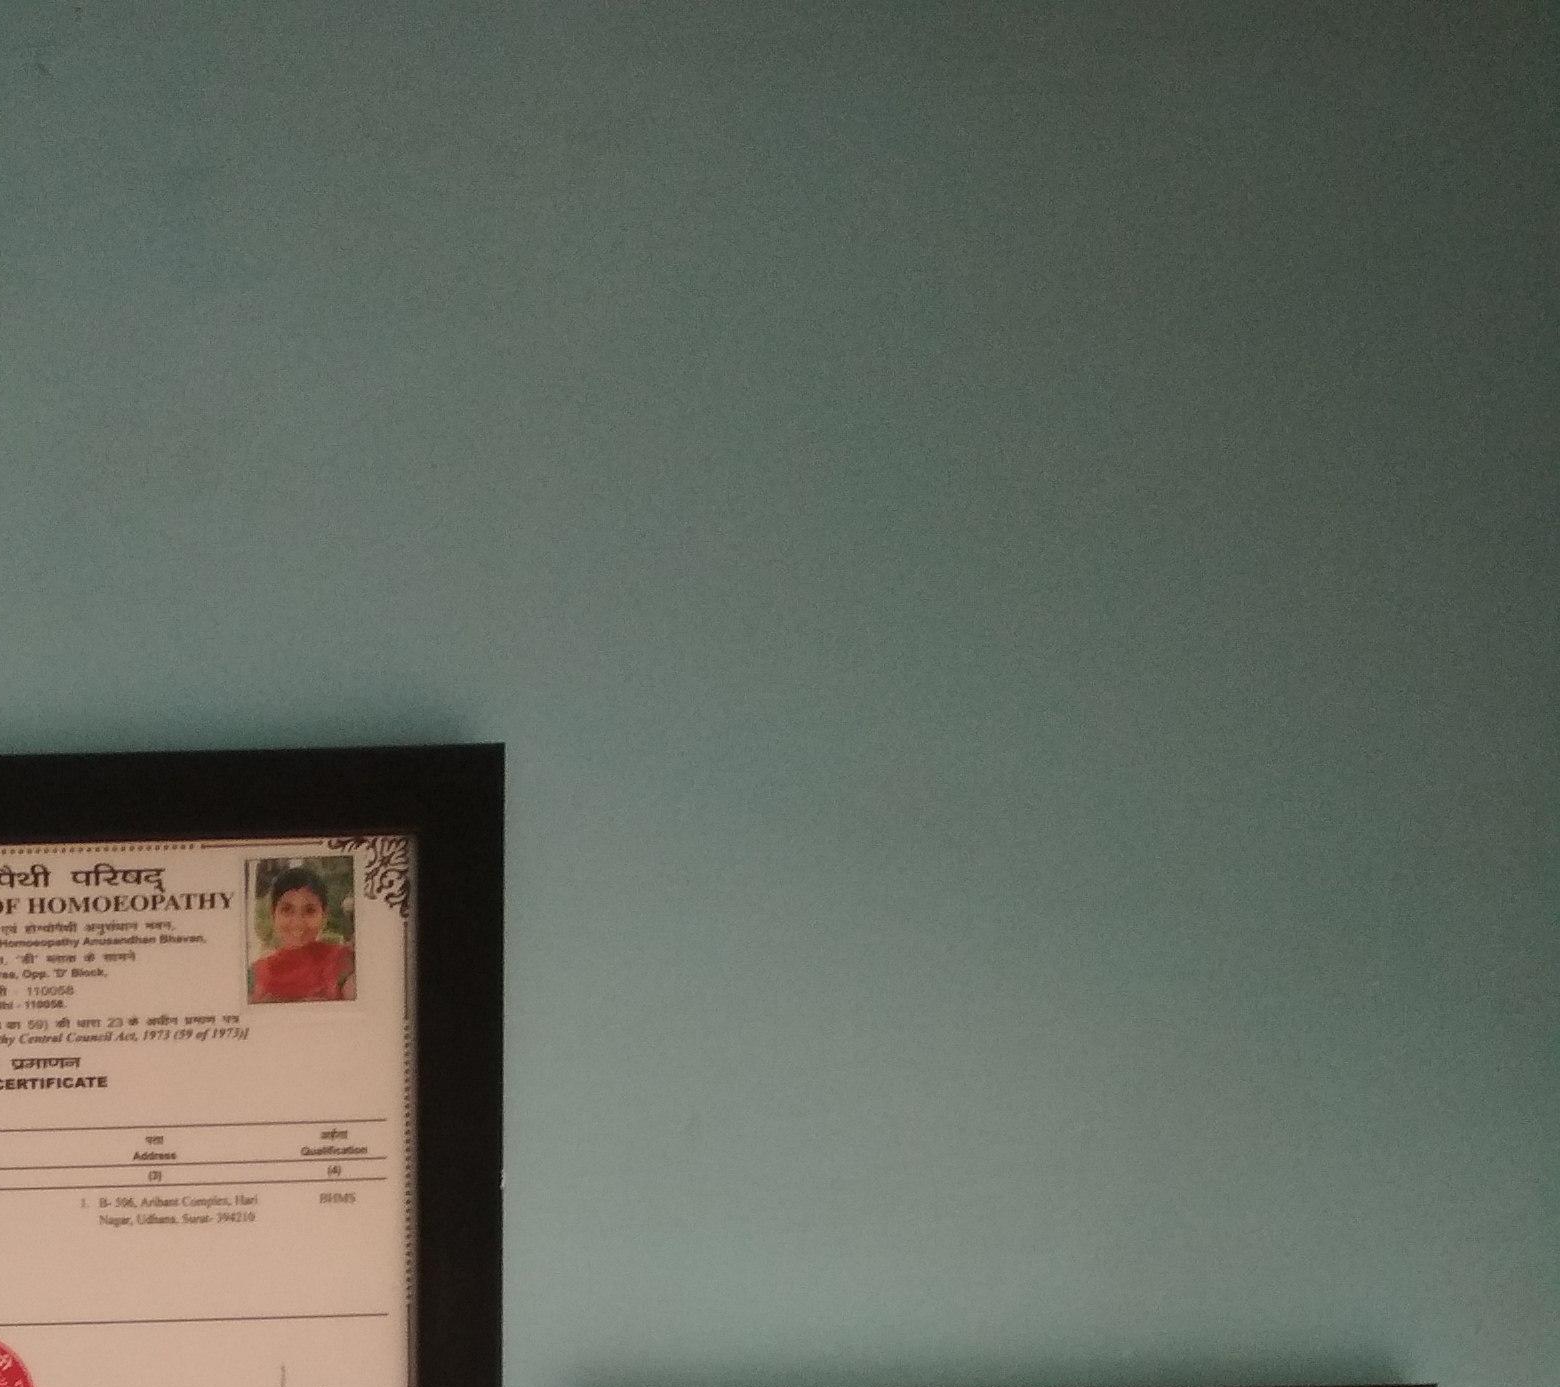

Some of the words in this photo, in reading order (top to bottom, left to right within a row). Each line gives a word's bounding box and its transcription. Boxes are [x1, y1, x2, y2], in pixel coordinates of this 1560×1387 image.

[71, 862, 165, 892] परिषद्
[28, 891, 234, 914] HOMOEOPATHY
[133, 1151, 177, 1161] Address
[301, 1145, 368, 1156] Qualification
